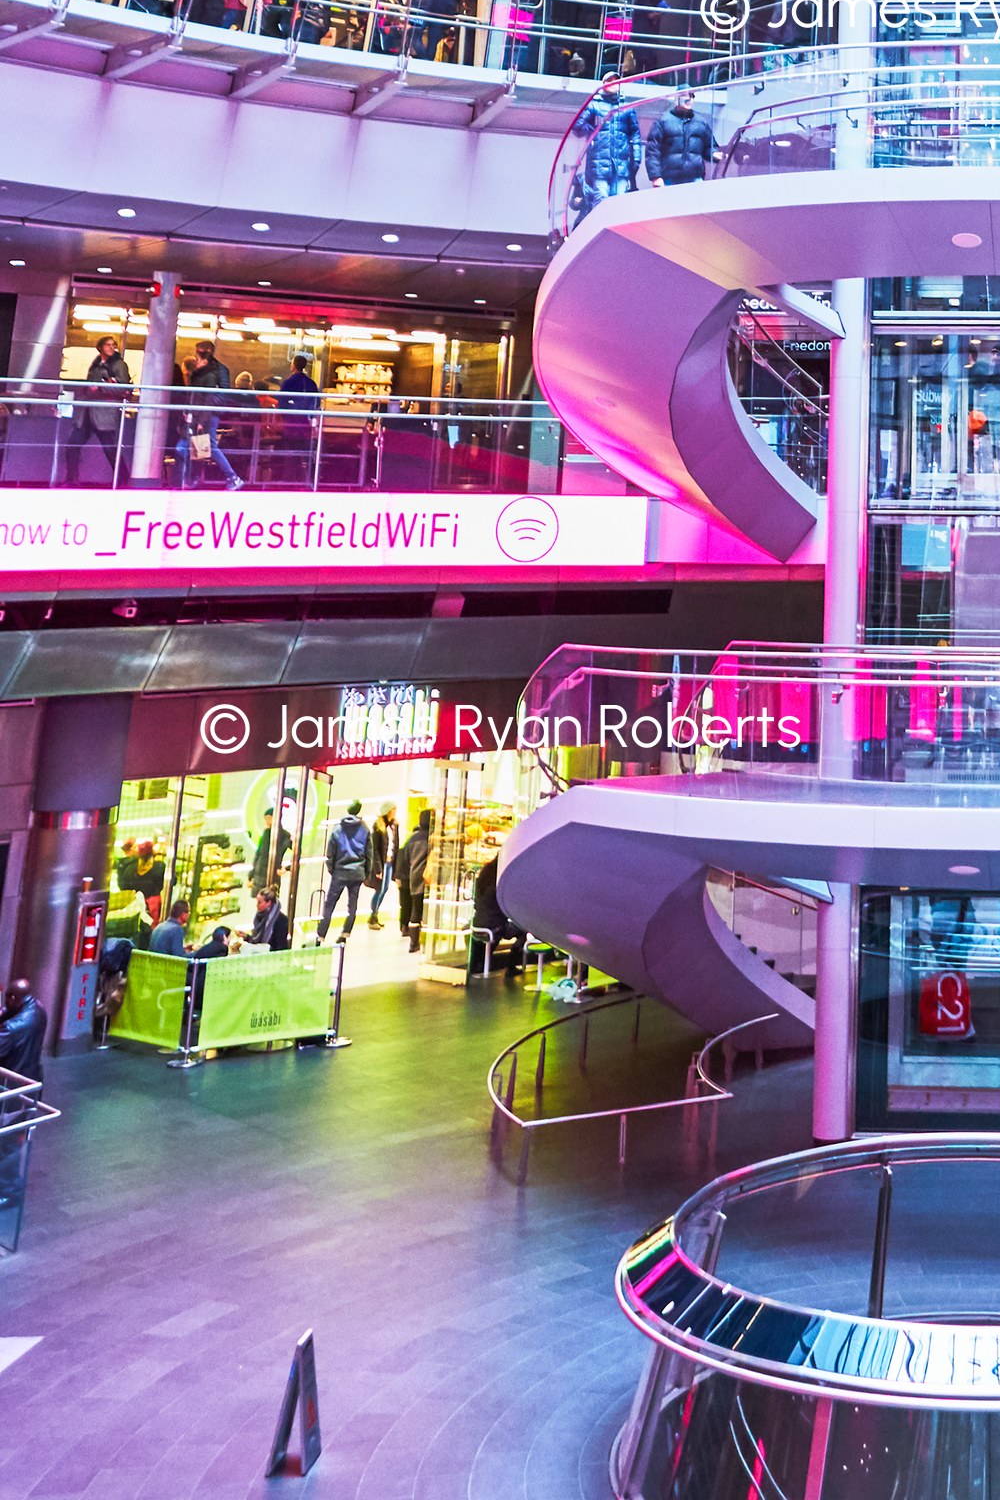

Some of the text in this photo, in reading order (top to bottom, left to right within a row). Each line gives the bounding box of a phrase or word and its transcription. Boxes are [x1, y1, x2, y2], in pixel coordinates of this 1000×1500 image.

[61, 518, 88, 546] to
[95, 511, 459, 556] _FreeWestfieldWiFi
[76, 973, 90, 1021] FIRE
[937, 973, 965, 1033] C21
